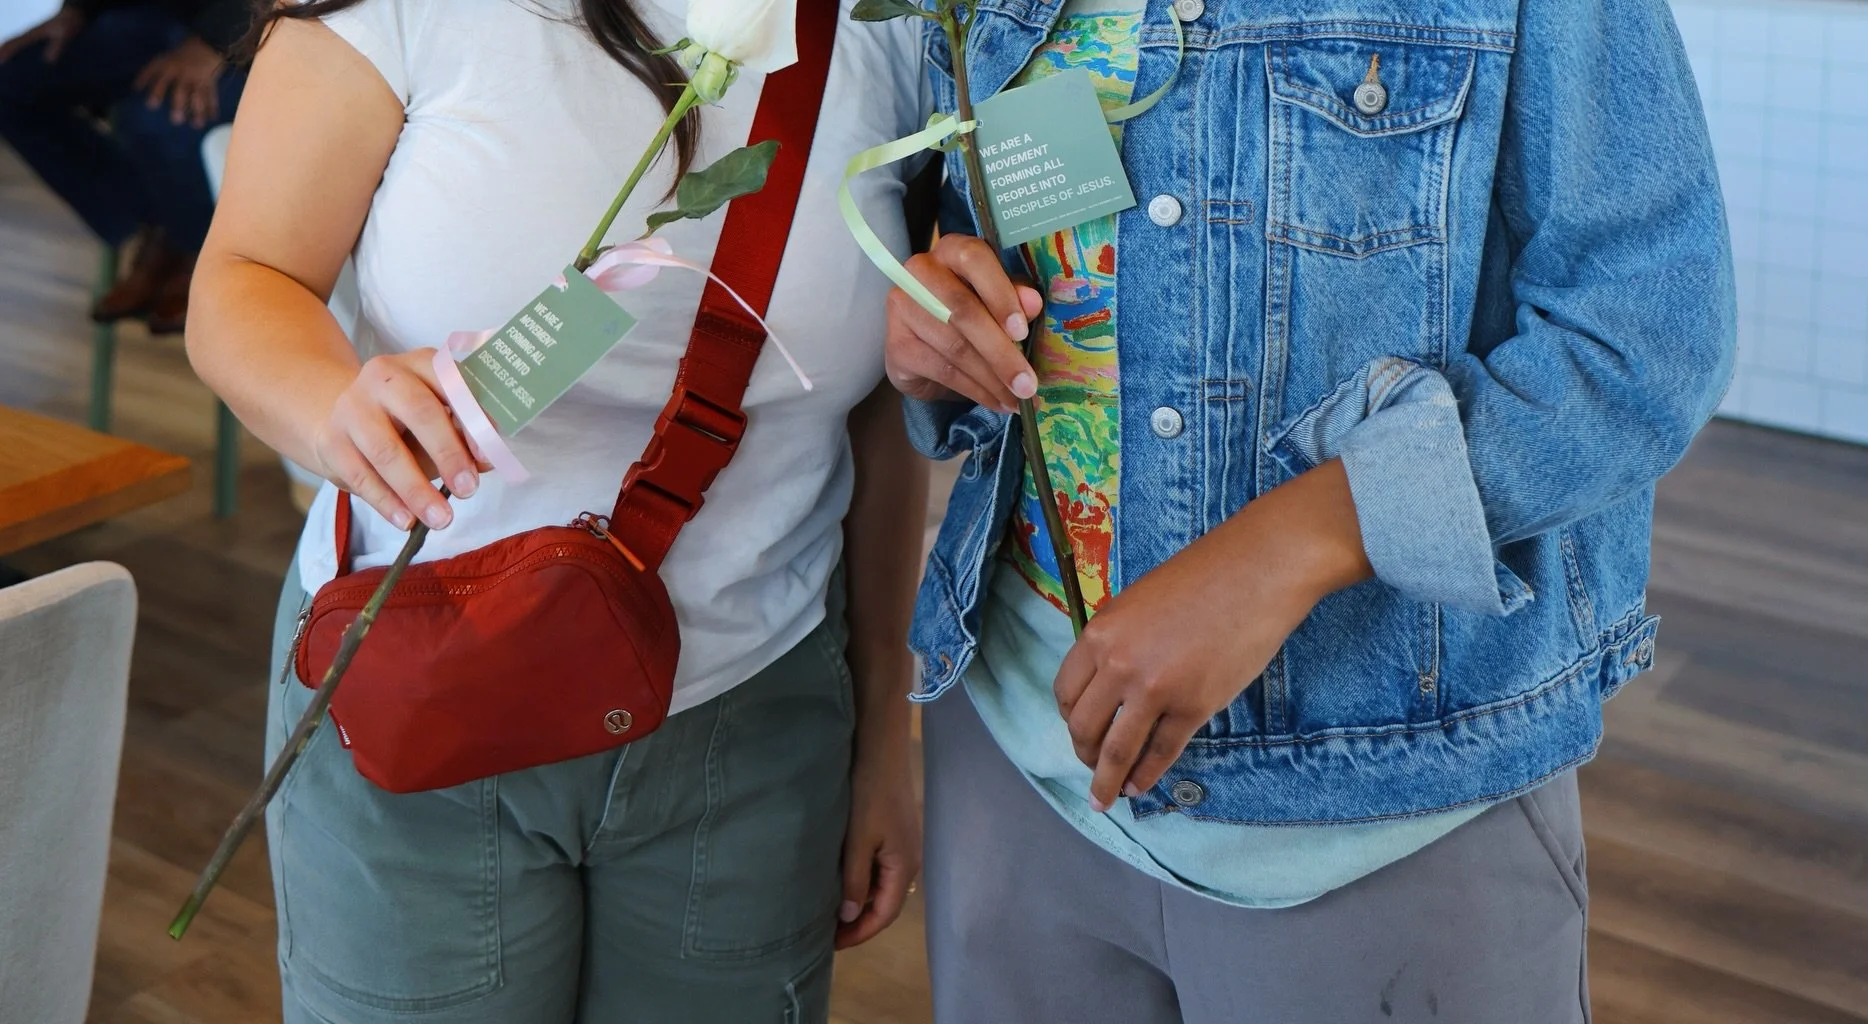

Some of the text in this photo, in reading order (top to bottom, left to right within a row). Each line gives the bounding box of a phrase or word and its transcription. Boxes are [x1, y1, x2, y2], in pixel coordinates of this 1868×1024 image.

[979, 133, 1033, 158] WE ARE A
[985, 144, 1049, 174] MOVEMENT
[990, 157, 1065, 189] FORMING ALL
[996, 173, 1067, 205] PEOPLE INTO
[1001, 194, 1058, 220] DISCIPLES
[1059, 188, 1075, 201] OF
[1077, 175, 1116, 196] JESUS.
[519, 314, 558, 349] MOVEMENT
[534, 301, 564, 332] WE ARE A
[492, 338, 531, 376] PEOPLE INTO
[506, 326, 547, 366] FORMING ALL
[478, 350, 510, 381] DISCIPLES
[504, 376, 518, 389] OF
